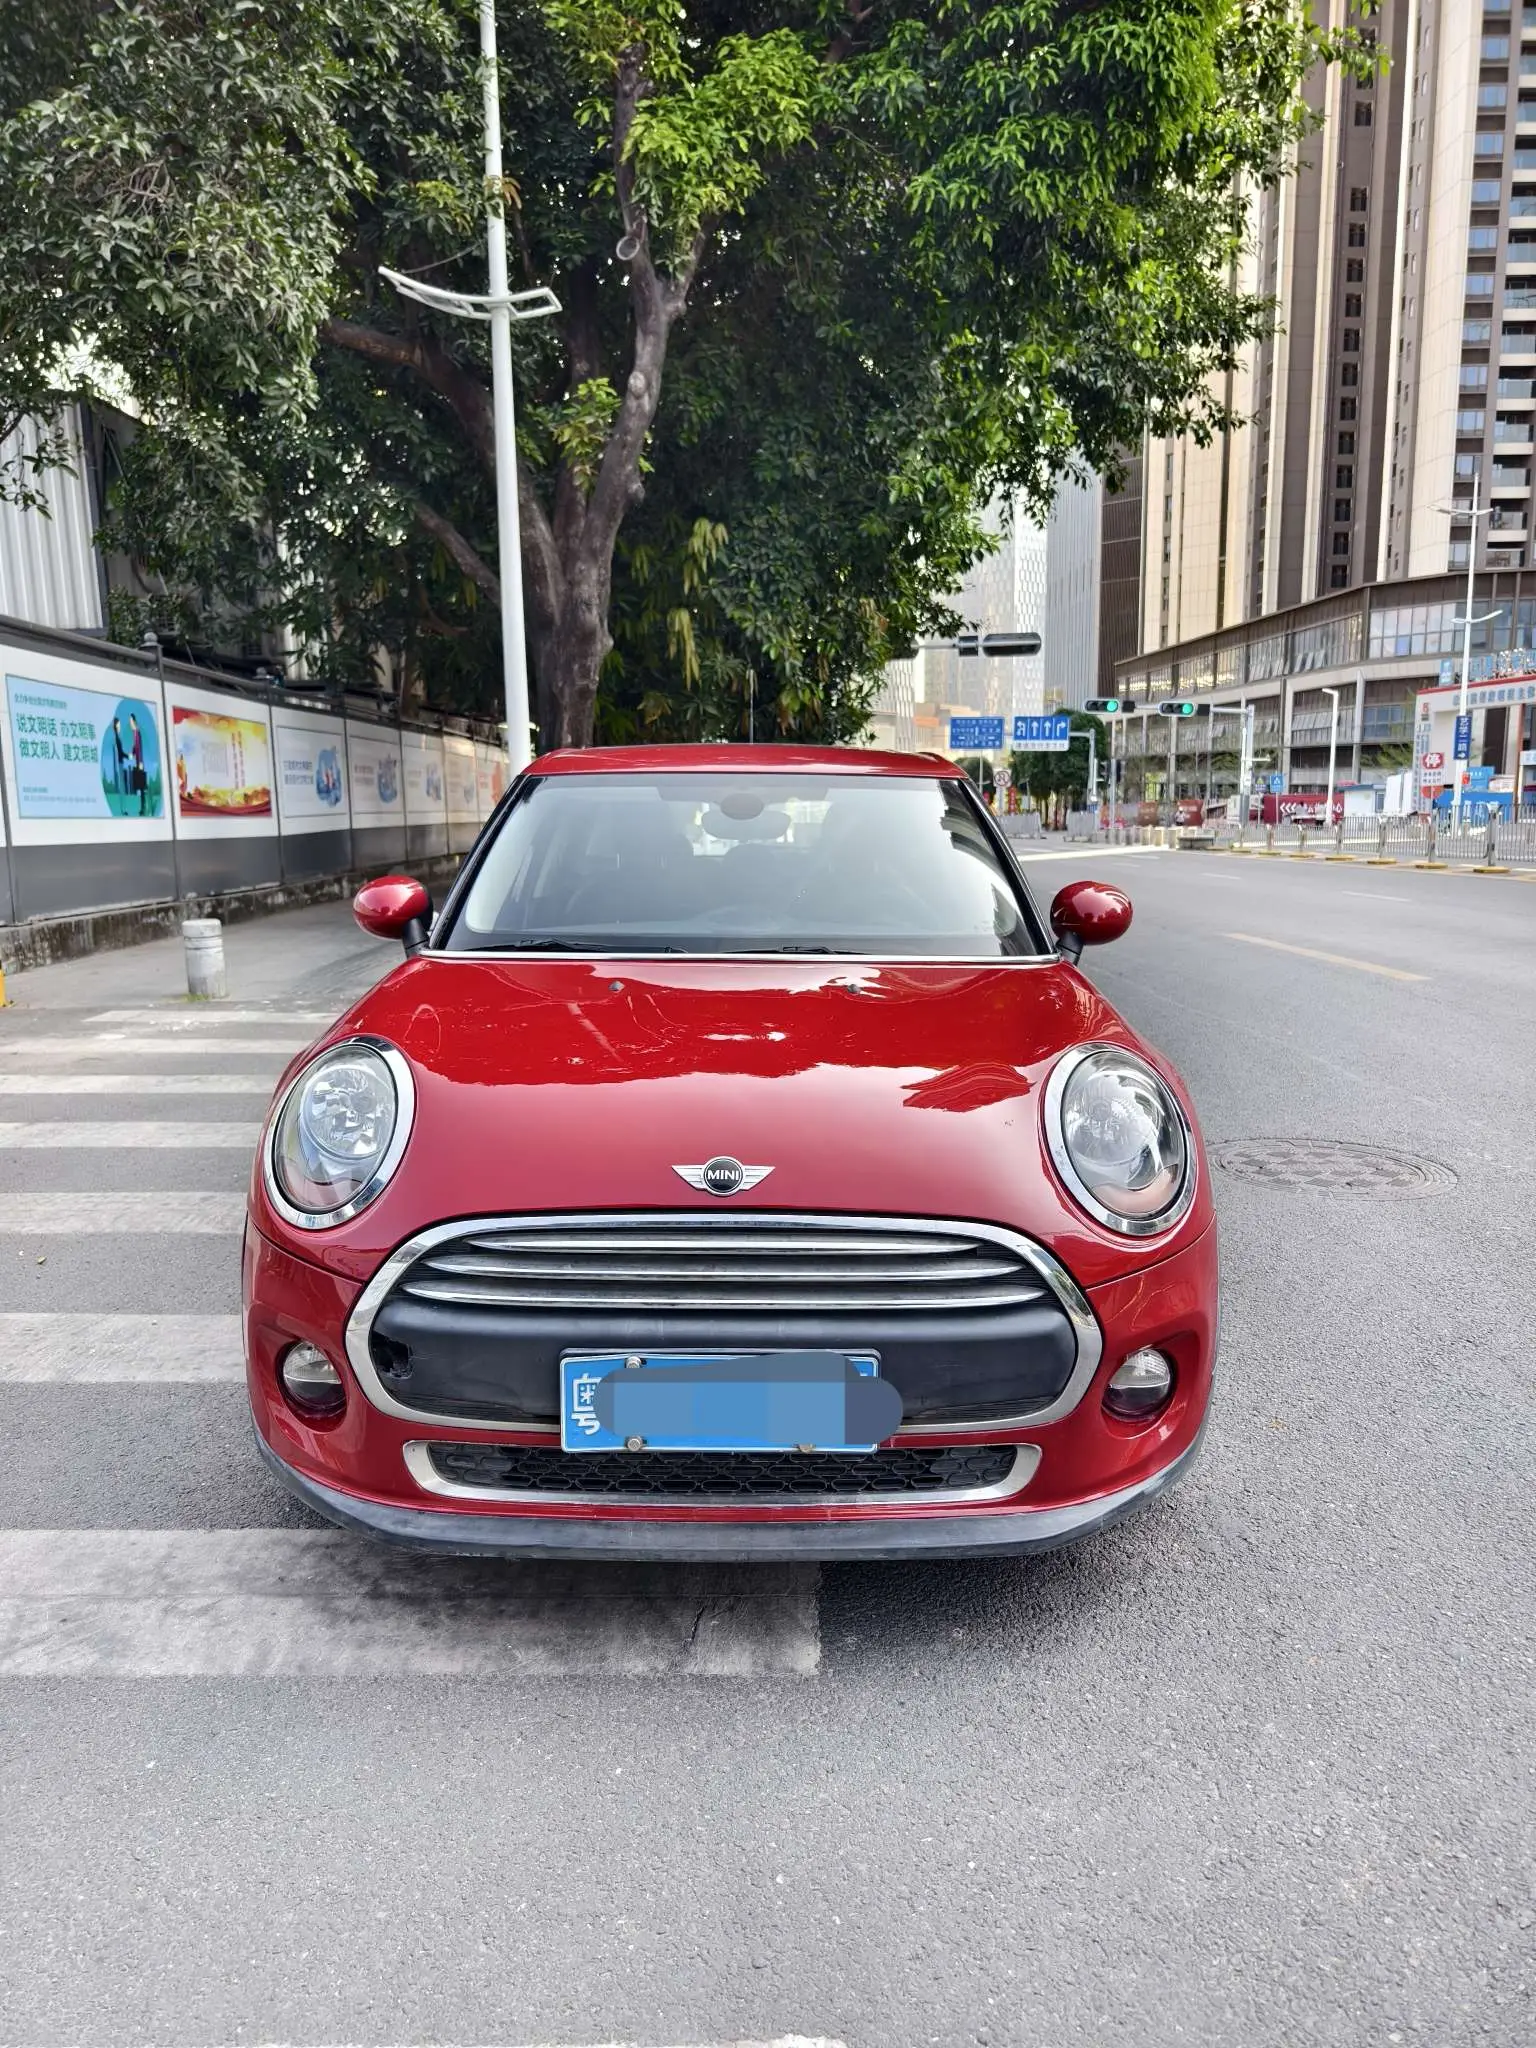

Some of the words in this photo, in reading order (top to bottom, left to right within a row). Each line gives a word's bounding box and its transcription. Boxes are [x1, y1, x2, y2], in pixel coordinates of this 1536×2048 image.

[16, 712, 57, 737] 说文明话
[19, 738, 60, 760] 做文明人
[1424, 753, 1442, 768] 停
[707, 1168, 740, 1181] MINI
